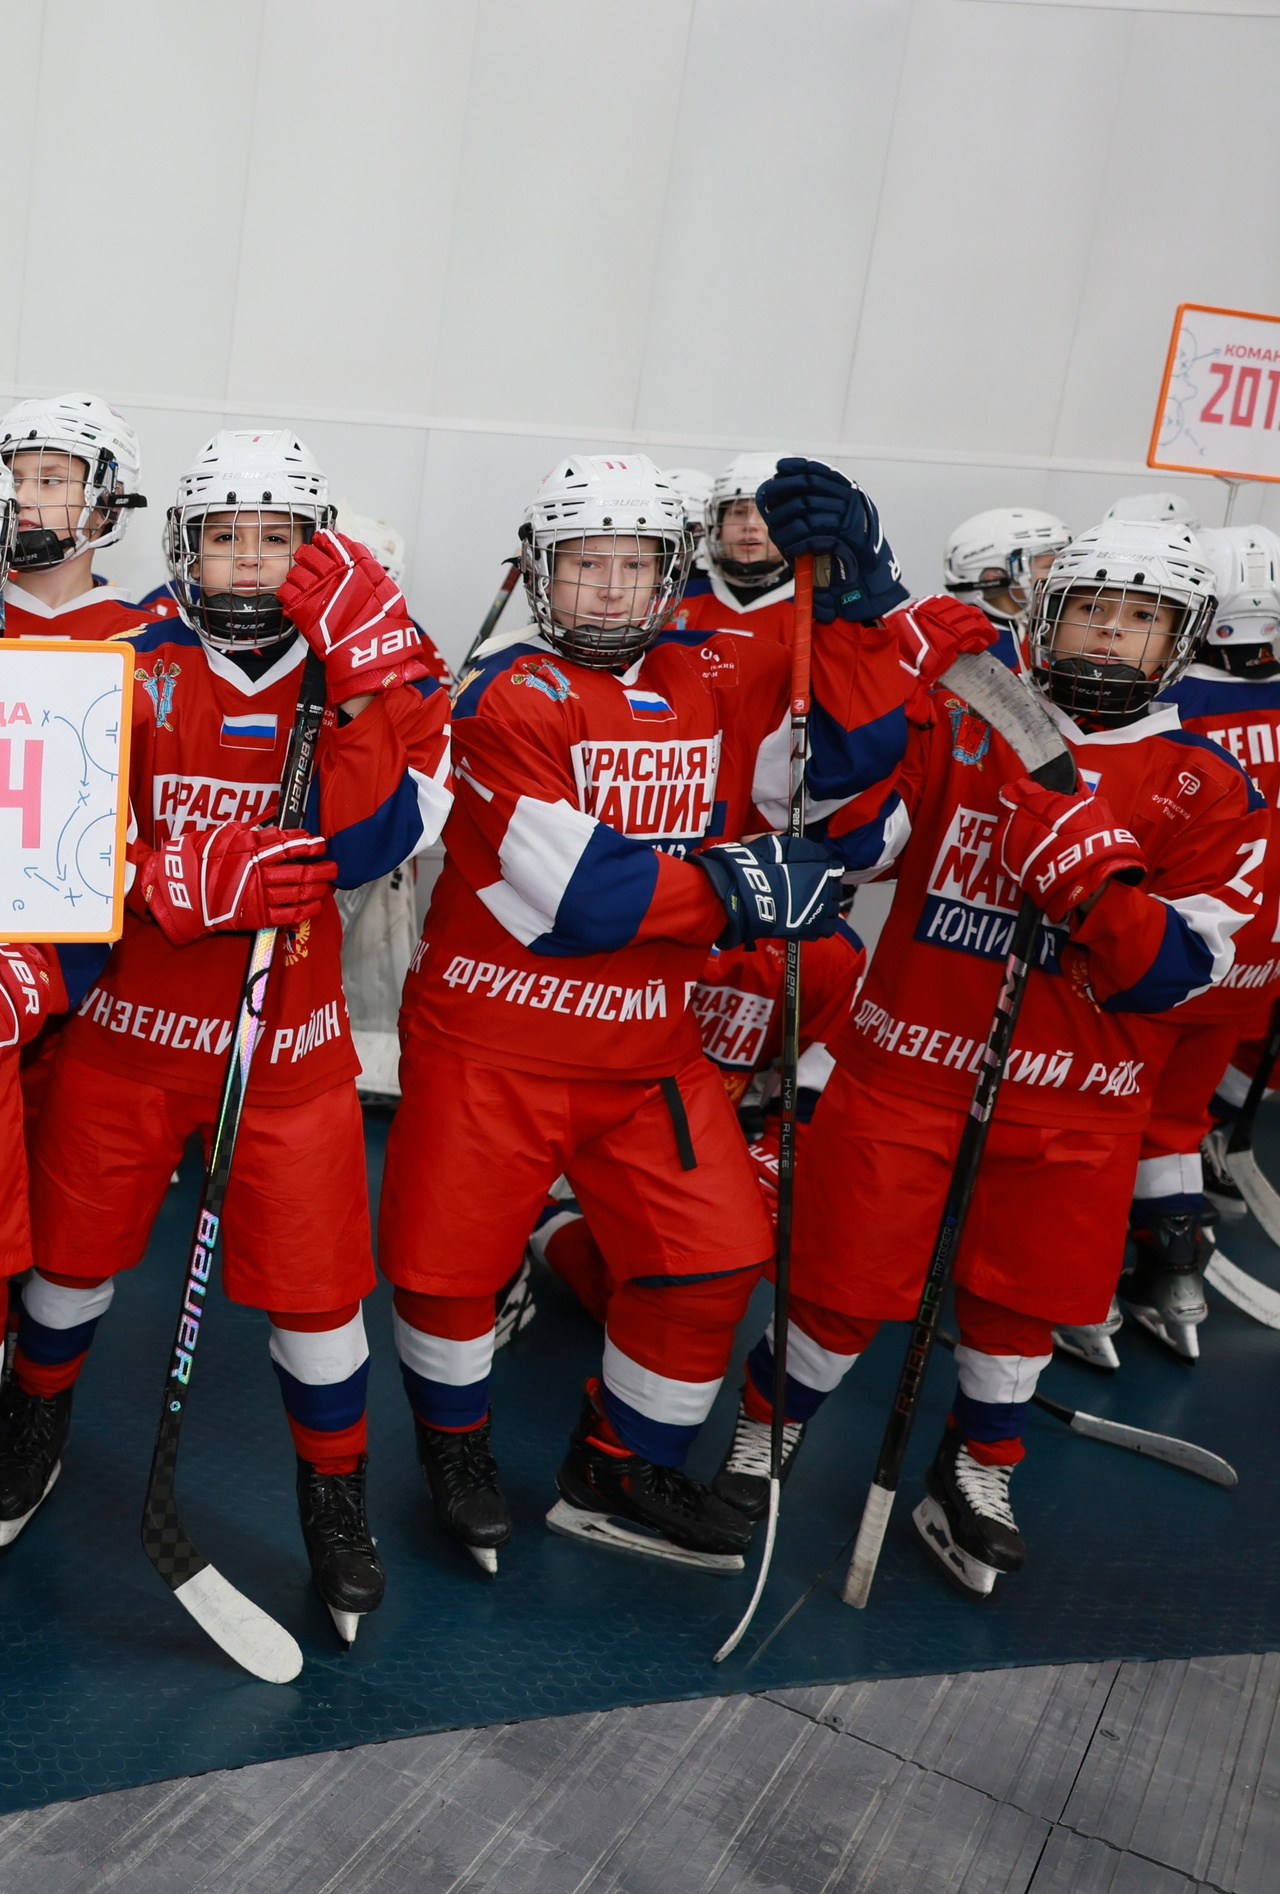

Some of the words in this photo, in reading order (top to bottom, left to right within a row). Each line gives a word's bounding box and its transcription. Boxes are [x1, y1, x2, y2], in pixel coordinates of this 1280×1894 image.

[1224, 344, 1280, 362] КОМАН
[1199, 362, 1280, 431] 201
[349, 627, 421, 668] UER
[1207, 723, 1280, 766] ТЕП
[159, 781, 280, 823] КРАСН
[289, 740, 311, 814] BAUER
[165, 836, 193, 911] BAU
[927, 903, 1057, 965] ЮНИР
[786, 941, 797, 998] BAUER
[270, 1000, 342, 1065] РАЙОН
[932, 1225, 953, 1278] TRIGGER
[170, 1209, 219, 1386] BAUER
